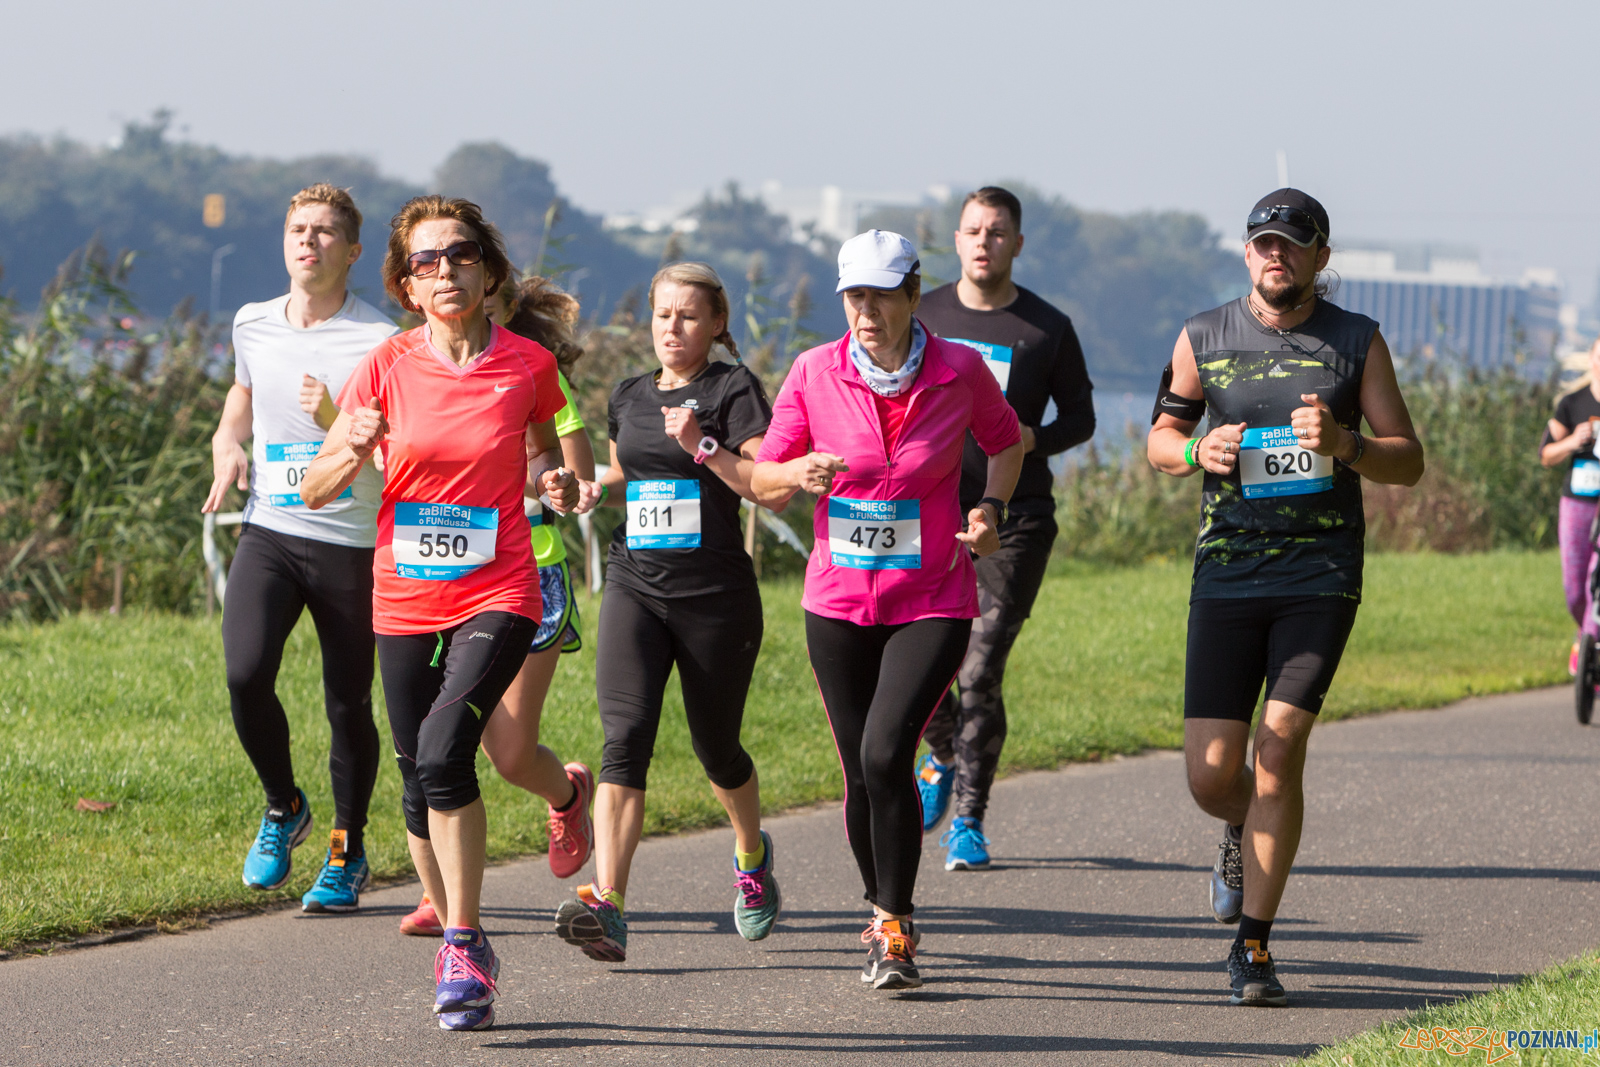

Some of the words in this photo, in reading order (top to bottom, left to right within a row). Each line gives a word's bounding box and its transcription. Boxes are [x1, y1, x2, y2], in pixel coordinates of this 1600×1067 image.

[1261, 427, 1295, 439] zaBIE
[283, 443, 322, 454] zaBIEGa
[1270, 438, 1299, 447] FUNdu
[1265, 451, 1312, 476] 620
[639, 482, 675, 493] zaBIEGaj
[643, 492, 675, 500] FUNdusze
[419, 505, 471, 521] zaBIEGaj
[849, 501, 897, 513] zaBIEGaj
[426, 517, 470, 527] FUNdusze
[639, 506, 672, 528] 611
[856, 512, 896, 520] FUNdusze
[849, 526, 896, 549] 473
[418, 533, 469, 558] 550
